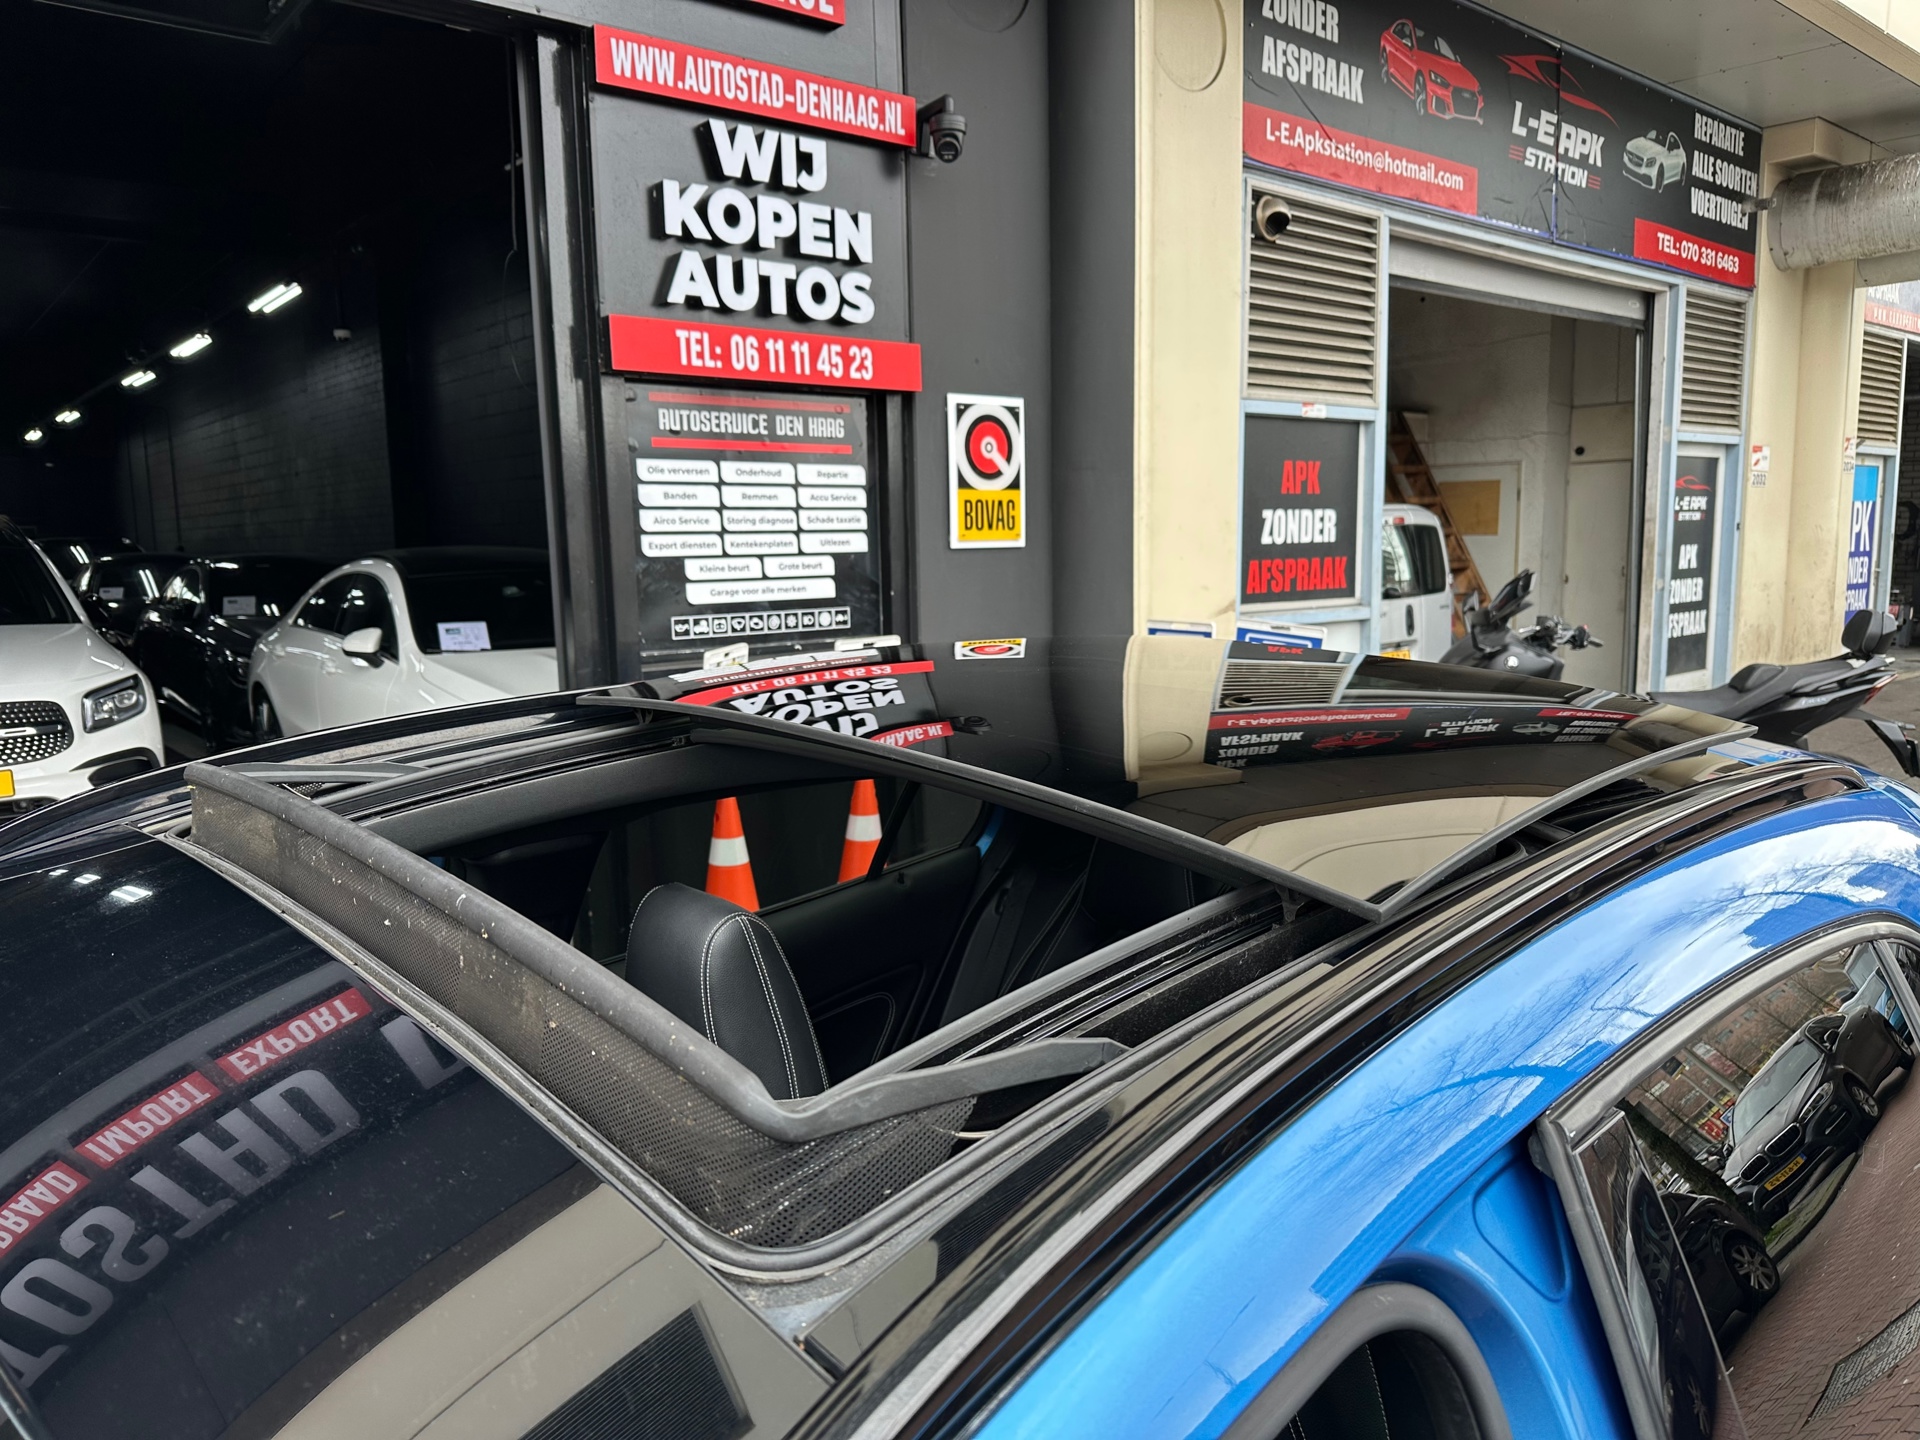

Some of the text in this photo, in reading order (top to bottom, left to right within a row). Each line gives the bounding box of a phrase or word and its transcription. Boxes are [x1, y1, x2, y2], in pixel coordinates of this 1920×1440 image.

[1262, 35, 1364, 104] AFSPRAAK
[610, 37, 906, 136] WWW.AUTOSTAD-DENHAAG.NL
[1512, 100, 1605, 168] L-E APK
[1694, 112, 1745, 156] REPARATIE
[707, 117, 828, 192] WIJ
[1266, 118, 1464, 190] L-E.Apkstation@hotmail.com
[1524, 146, 1588, 188] STATION
[1692, 150, 1758, 197] ALLE SOORTEN
[661, 178, 874, 263] KOPEN
[1657, 232, 1739, 273] TEL: 070 331 6463
[667, 249, 875, 324] AUTOS
[675, 328, 873, 381] TEL: 06 11 11 45 23
[658, 408, 845, 438] AUTOSERVICE DEN HAAG
[647, 466, 710, 475] Olie verversen
[735, 468, 781, 477] Onderhoud
[1281, 460, 1321, 495] APK
[663, 492, 697, 500] Banden
[653, 516, 709, 525] Airco Service
[727, 516, 793, 526] Storing diagnose
[807, 515, 861, 524] Schade taxatie
[964, 499, 1015, 531] BOVAG
[1261, 508, 1337, 545] ZONDER
[649, 541, 717, 550] Export diensten
[730, 540, 793, 549] Kentekenplaten
[820, 539, 850, 547] Uitlezen
[1678, 544, 1698, 569] APK
[700, 564, 750, 573] Kleine beurt
[802, 562, 822, 570] beurt
[1246, 556, 1347, 594] AFSPRAAK
[710, 585, 807, 597] Garage voor alle merken
[1669, 577, 1703, 604] ZONDER
